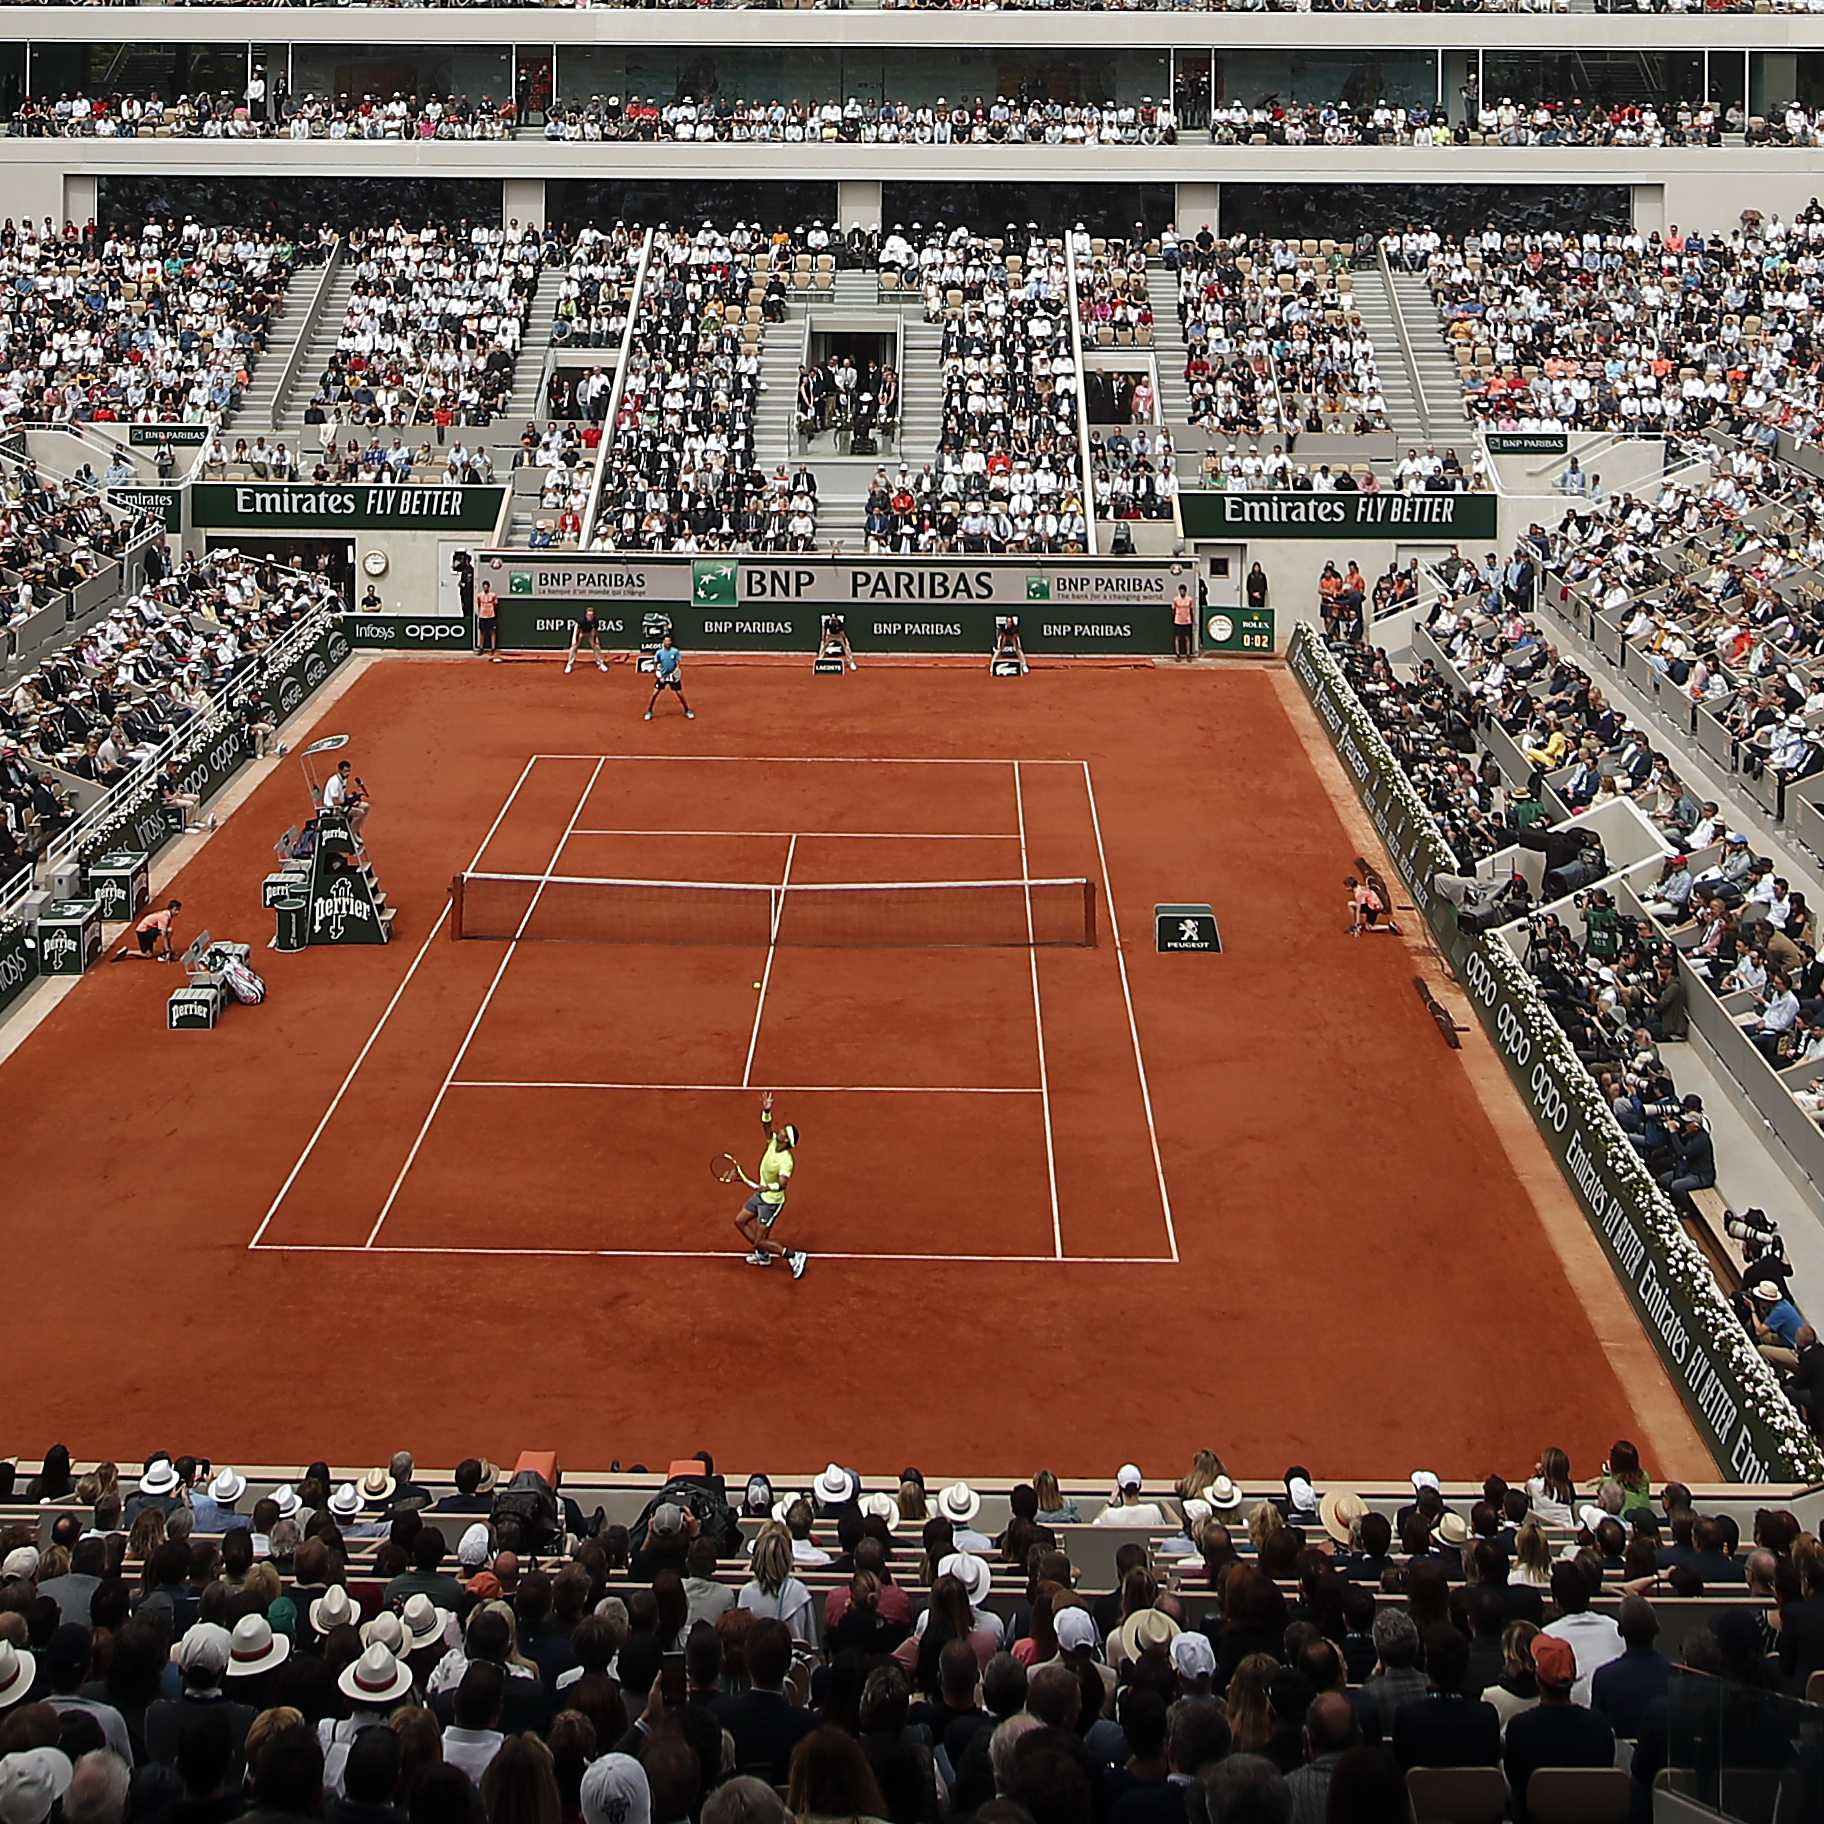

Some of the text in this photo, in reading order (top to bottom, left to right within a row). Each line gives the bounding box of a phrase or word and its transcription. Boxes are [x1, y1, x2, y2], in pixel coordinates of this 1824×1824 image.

[145, 431, 205, 440] BNP PARIBAS
[1502, 439, 1564, 449] BNP PARIBAS
[116, 492, 172, 506] Emirates
[236, 487, 463, 516] Emirates FLY BETTER
[1224, 496, 1454, 524] Emirates FLY BETTER
[538, 572, 646, 588] BNP PARIBAS
[746, 570, 994, 600] BNP PARIBAS
[1056, 577, 1164, 592] BNP PARIBAS
[354, 623, 396, 640] Infosys
[405, 623, 465, 641] oppo
[536, 619, 624, 632] BNP PBAS
[704, 621, 793, 634] BNP PARIBAS
[873, 622, 962, 636] BNP PARIBAS
[1043, 624, 1131, 637] BNP PARIBAS
[1242, 620, 1270, 629] ROLEX
[1243, 634, 1269, 648] 0:02
[210, 732, 240, 772] oppo
[266, 883, 289, 907] perri
[313, 892, 371, 934] perrier
[1167, 941, 1210, 949] PEUGEOT
[1467, 950, 1497, 1009] oppo
[1497, 1002, 1531, 1067] oppo
[1530, 1061, 1568, 1134] oppo
[1565, 1130, 1608, 1218] Emirates
[1613, 1214, 1646, 1280] BETTER
[1638, 1262, 1739, 1445] Emirates FLY BETTER
